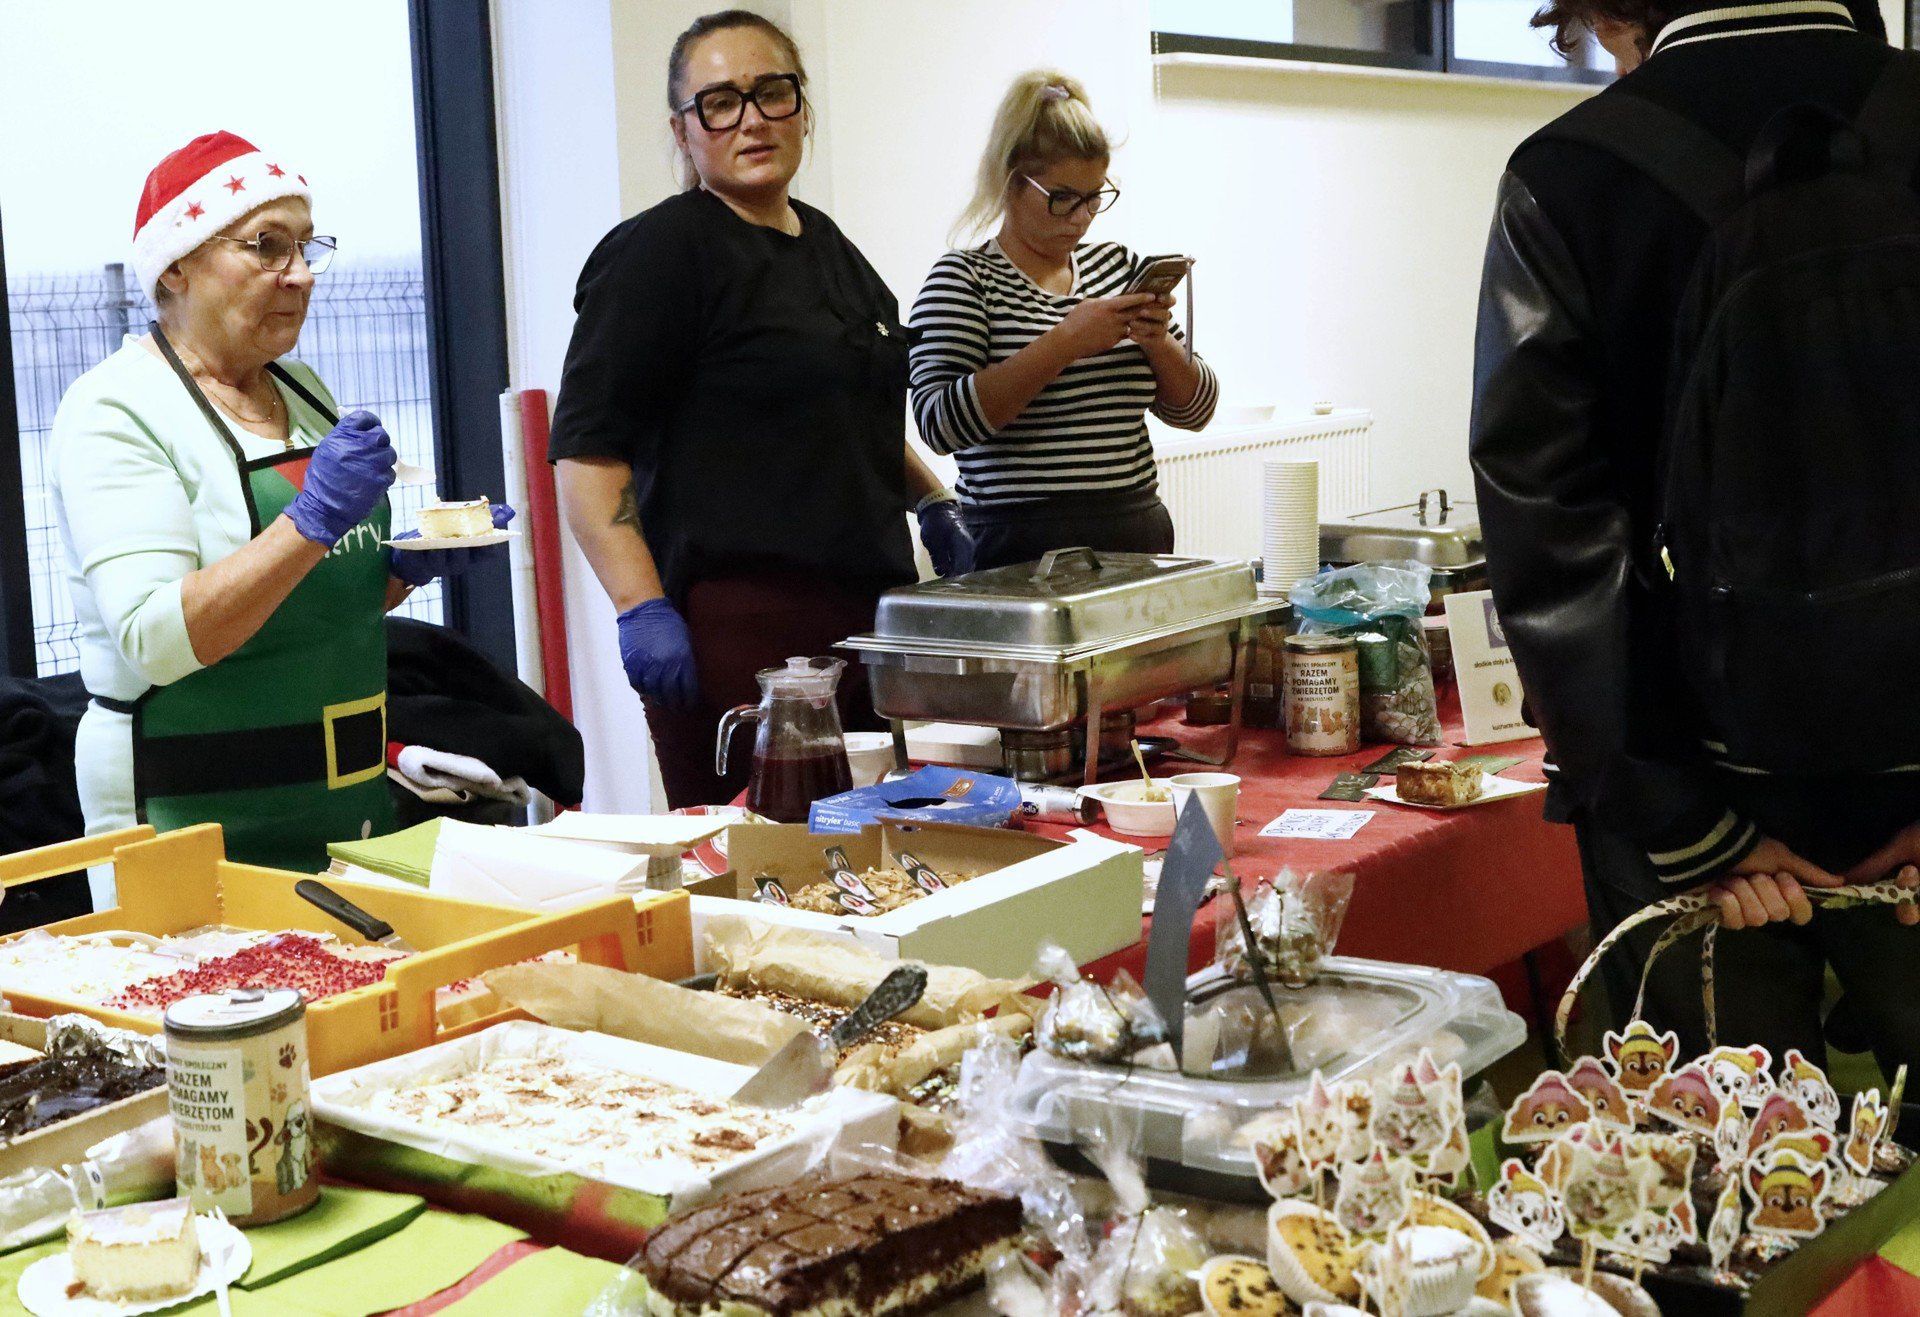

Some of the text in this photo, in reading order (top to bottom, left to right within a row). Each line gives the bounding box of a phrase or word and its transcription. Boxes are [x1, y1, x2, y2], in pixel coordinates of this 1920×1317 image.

[324, 522, 382, 559] erry
[1300, 669, 1328, 678] RAZEM
[1292, 677, 1337, 687] POMAGAMY
[1291, 686, 1340, 696] ZWIERZĘTOM
[814, 814, 842, 826] nitrylex
[173, 1069, 212, 1088] RAZEM
[171, 1099, 235, 1122] IERZĘTOM
